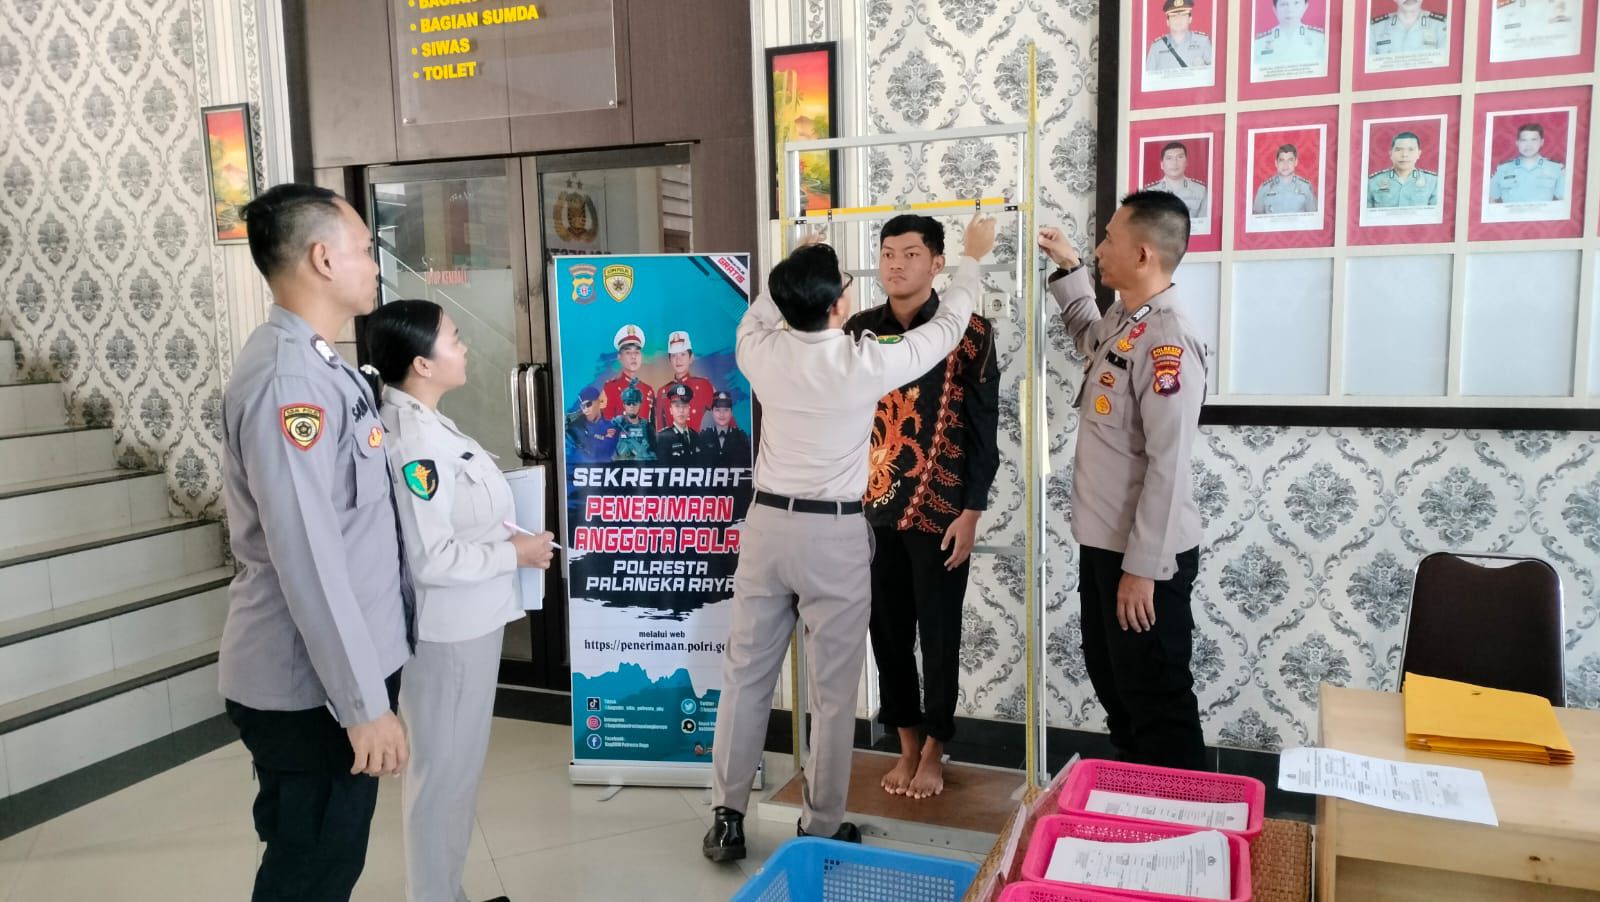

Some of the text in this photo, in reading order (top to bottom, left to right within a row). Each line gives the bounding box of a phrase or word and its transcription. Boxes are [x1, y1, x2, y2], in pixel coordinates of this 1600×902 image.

[420, 4, 539, 33] BAGIAN SUMDA
[421, 38, 471, 57] SIWAS
[422, 61, 477, 81] TOILET
[717, 256, 746, 285] GRATIS
[573, 467, 746, 488] SEKRETARIAT
[585, 495, 734, 522] PENERIMAAN
[574, 526, 741, 553] ANGGOTA POLR
[613, 560, 708, 575] POLRESTA
[586, 577, 684, 592] PALANGKA
[638, 630, 686, 639] melalui web
